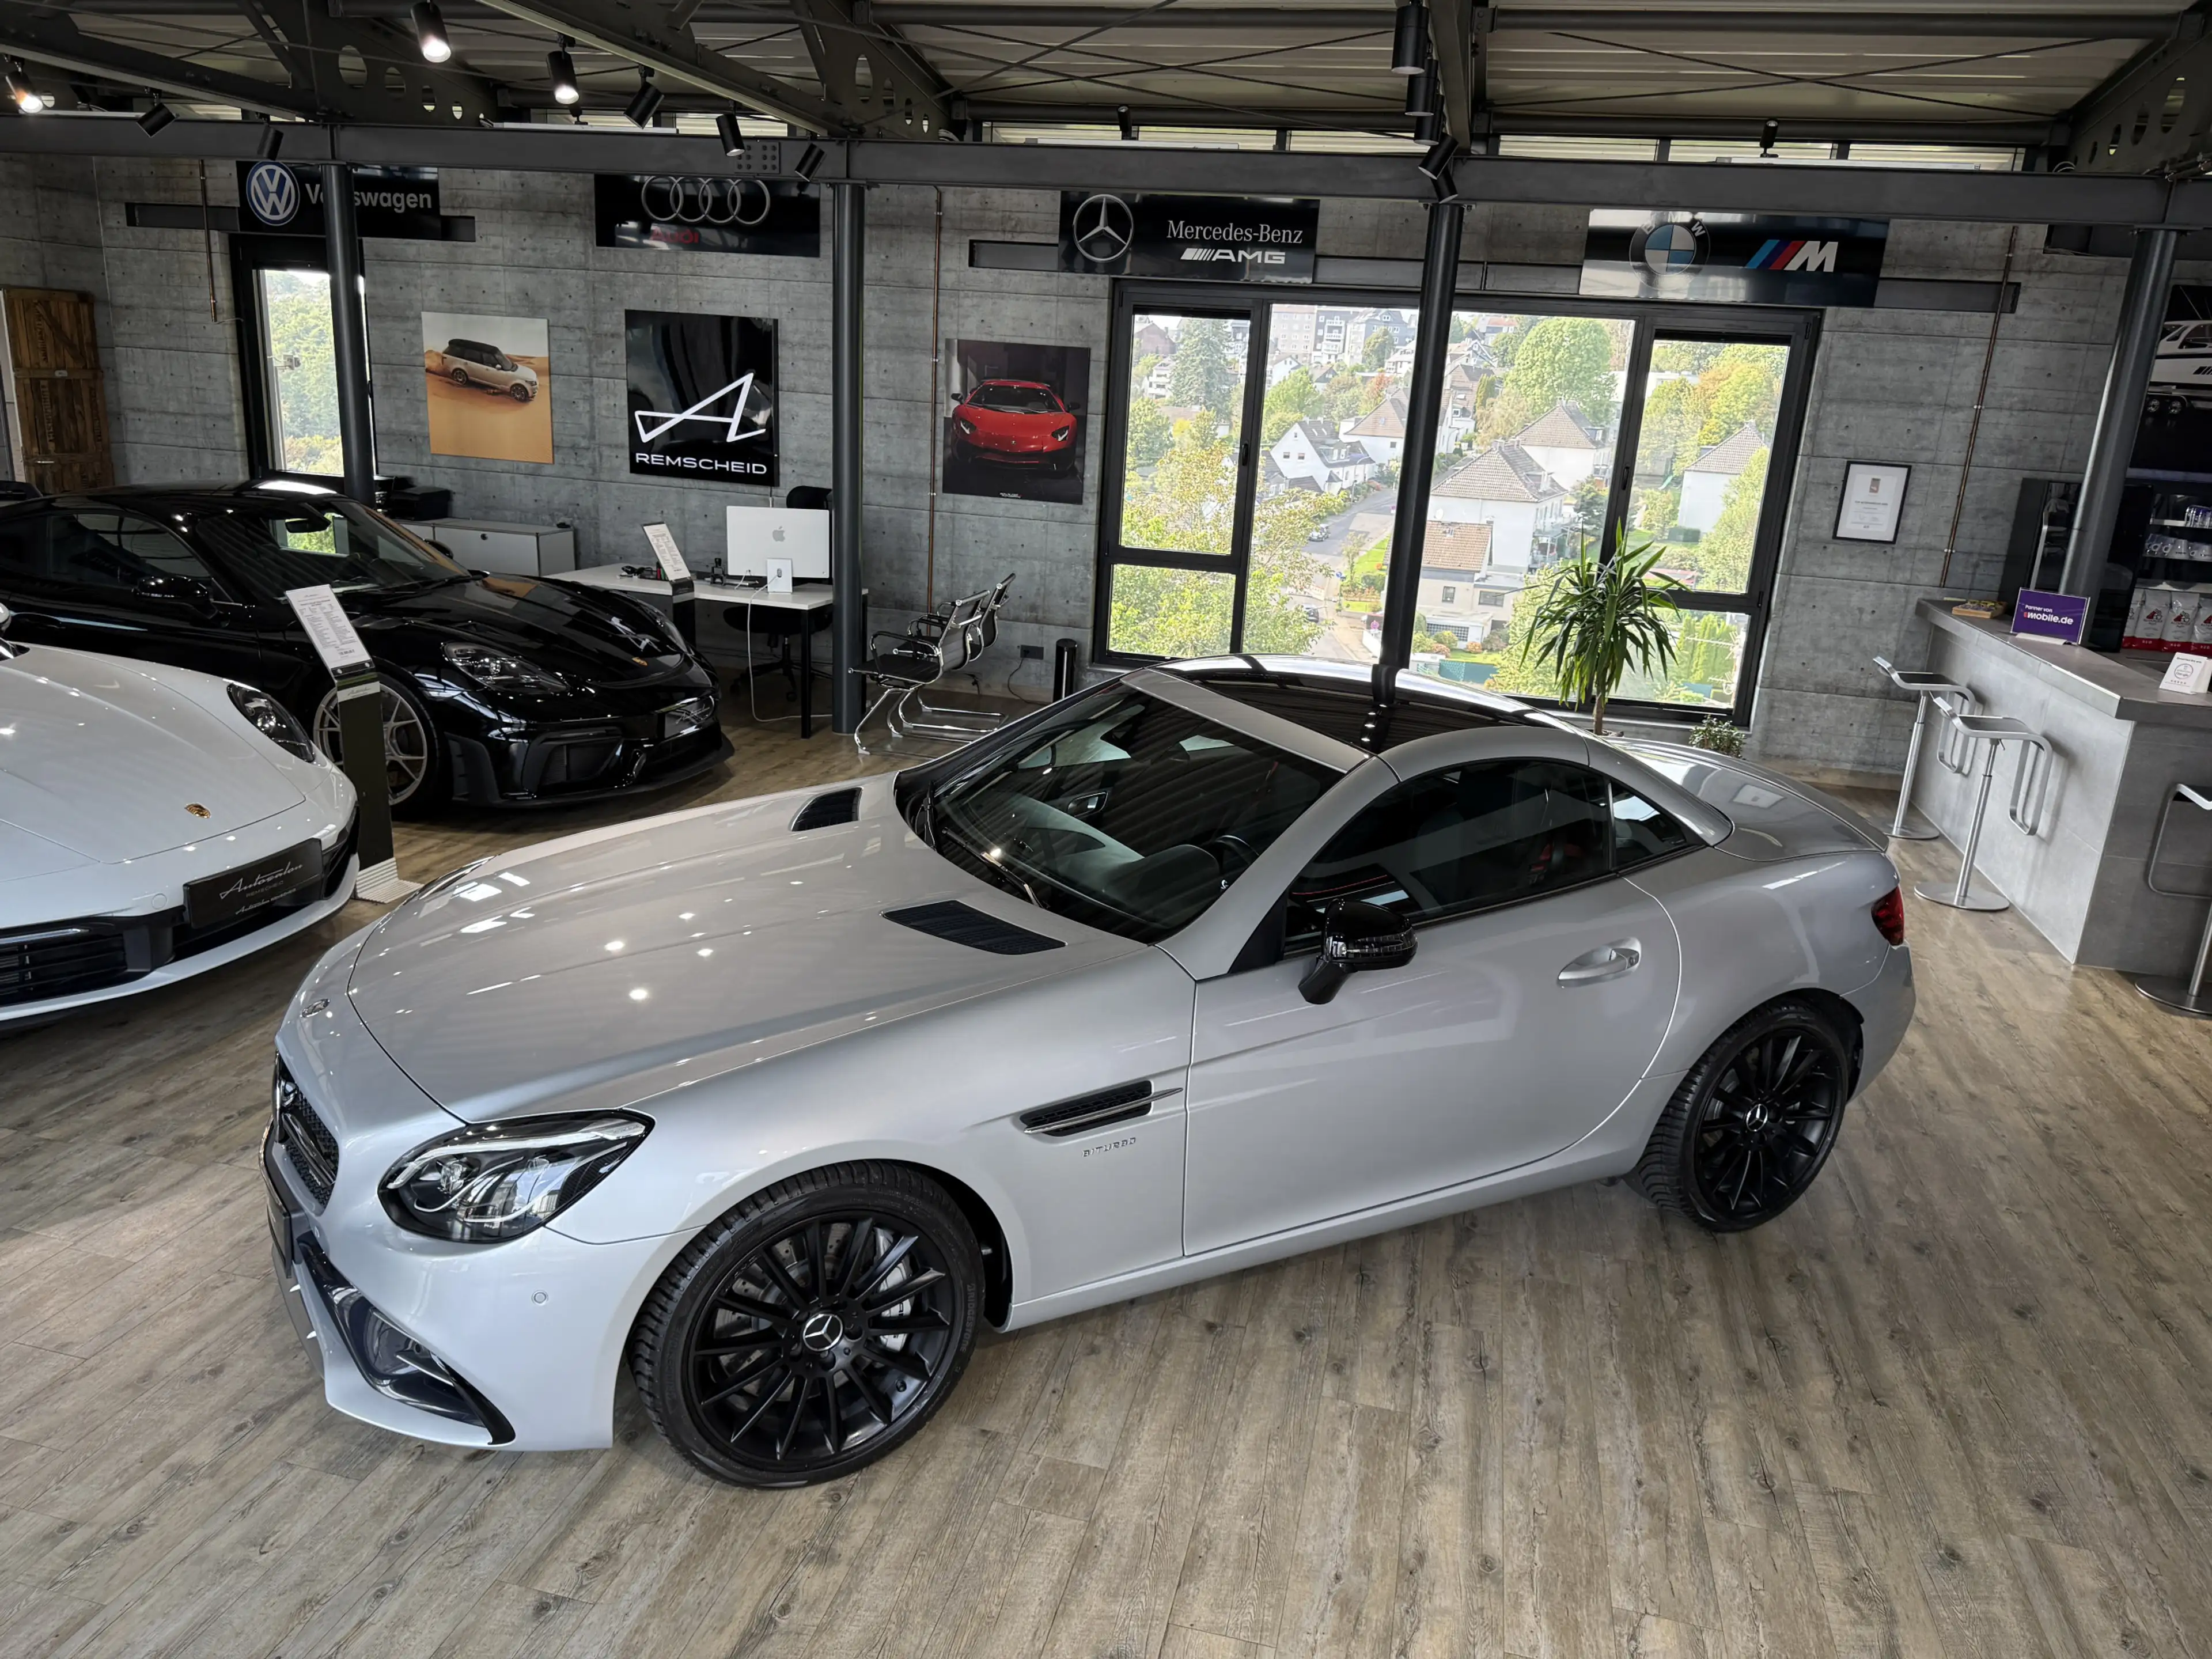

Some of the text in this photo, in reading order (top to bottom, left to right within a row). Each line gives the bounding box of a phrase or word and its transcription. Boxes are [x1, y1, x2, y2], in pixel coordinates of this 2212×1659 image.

[649, 228, 699, 244] Audi
[1166, 219, 1303, 244] Mercedes-Benz
[635, 453, 767, 475] REMSCHEID
[2027, 612, 2074, 625] mobile.de
[1082, 1137, 1137, 1157] BITURBO
